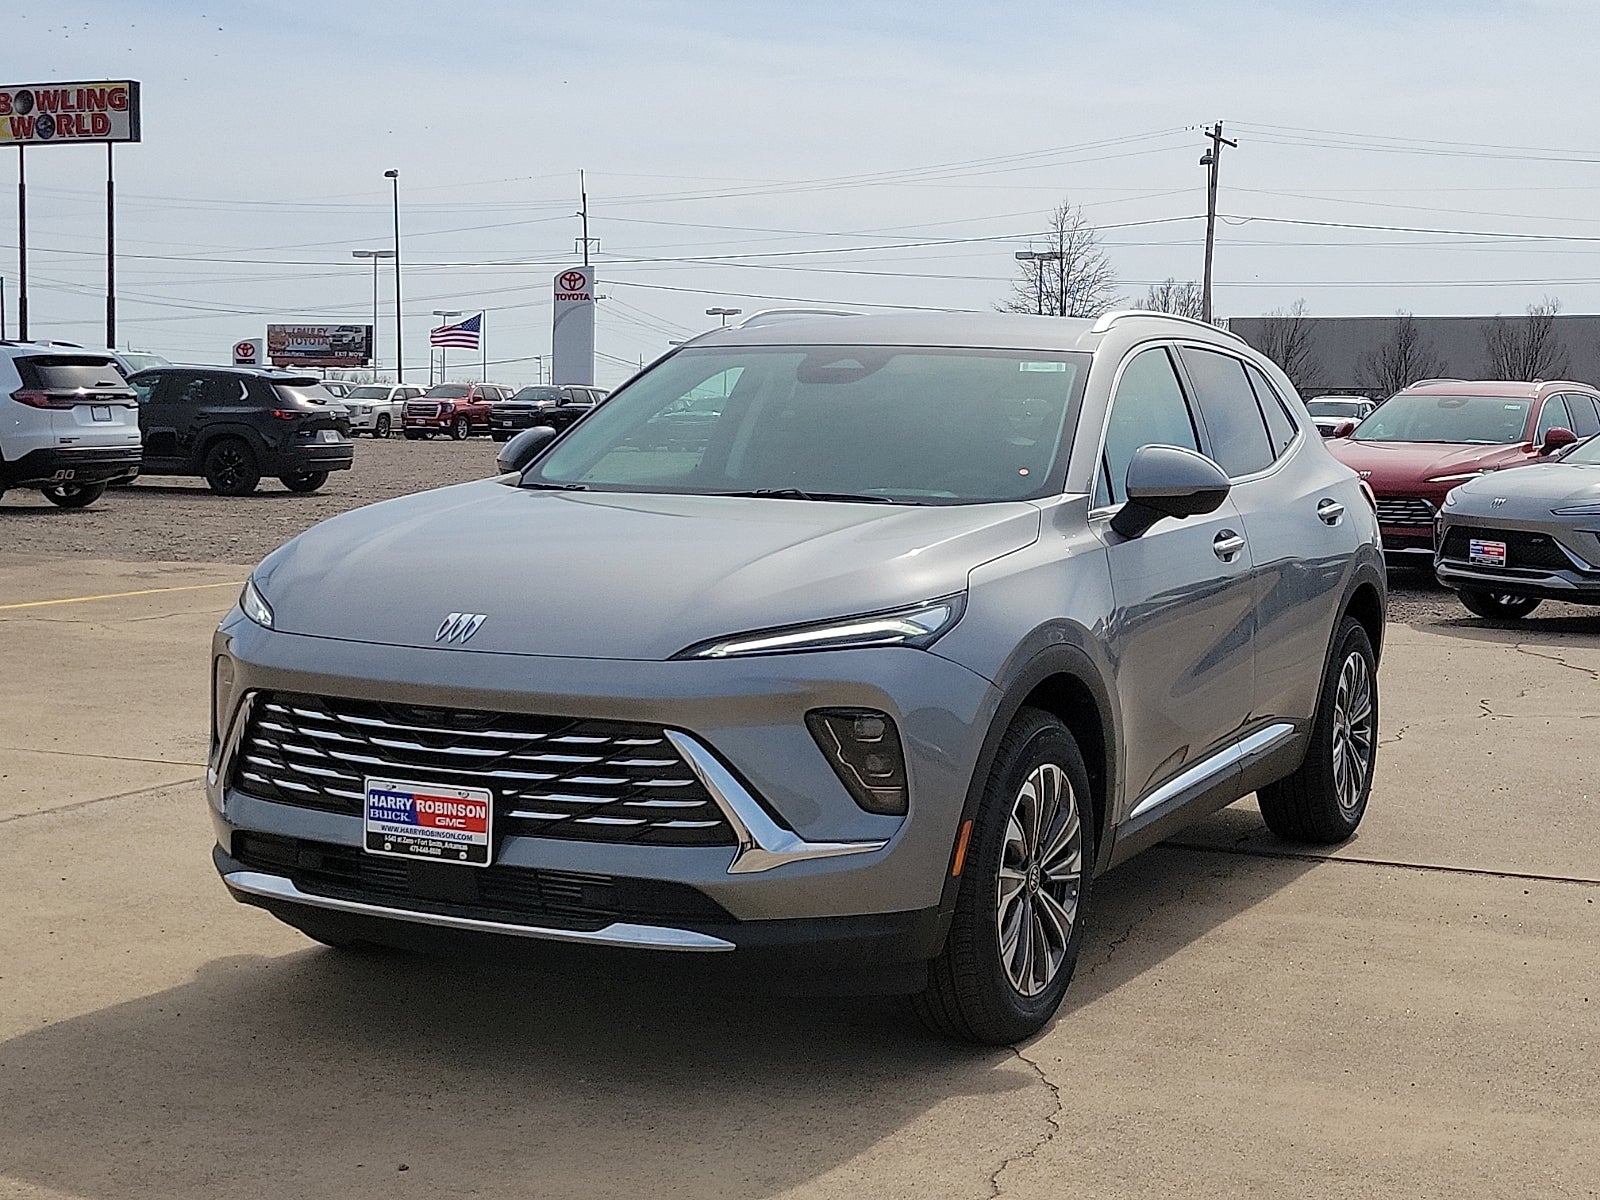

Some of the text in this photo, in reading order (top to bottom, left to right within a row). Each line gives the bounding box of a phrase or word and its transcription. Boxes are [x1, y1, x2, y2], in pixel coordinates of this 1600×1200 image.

[0, 87, 129, 116] BOWLING
[9, 113, 111, 140] WORLD
[555, 293, 591, 301] TOYOTA
[290, 337, 330, 346] TOYOTA
[369, 794, 486, 819] HARRY ROBINSON
[370, 808, 409, 821] BUICK
[435, 817, 467, 828] GMC
[381, 825, 473, 841] WWW.HARRYROBINSON.COM
